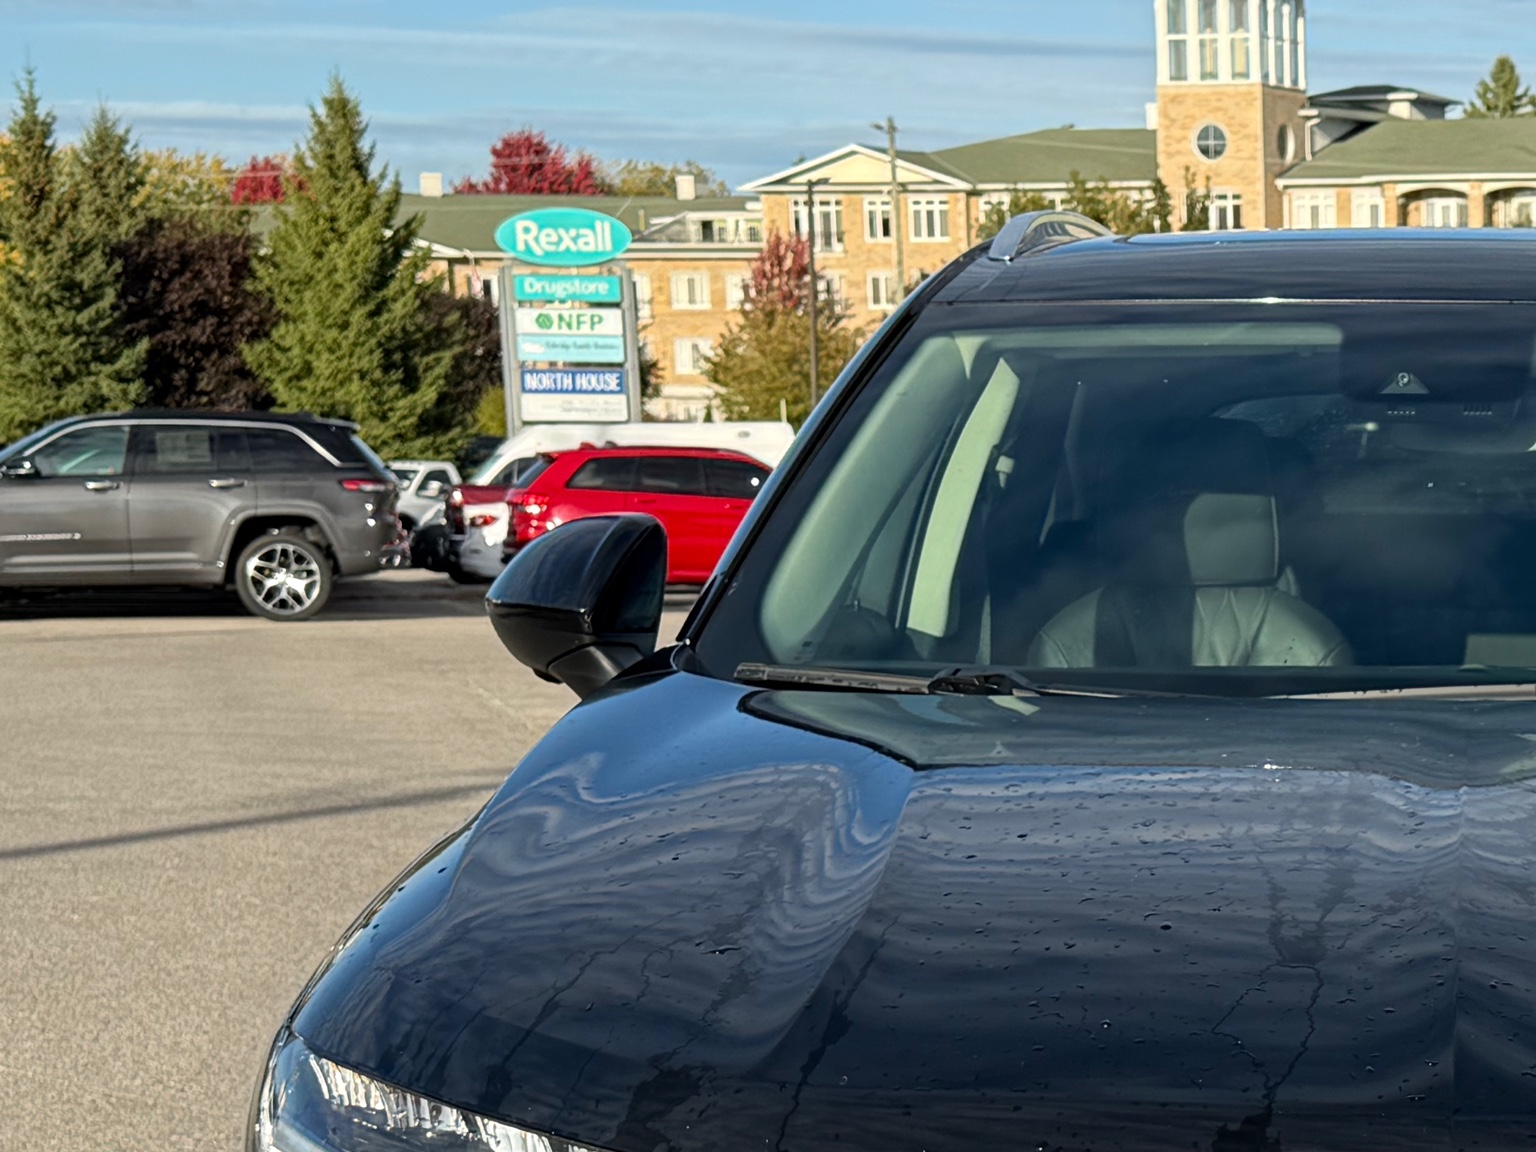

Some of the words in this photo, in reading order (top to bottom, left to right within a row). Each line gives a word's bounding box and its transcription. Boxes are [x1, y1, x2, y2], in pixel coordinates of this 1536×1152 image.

[515, 219, 613, 256] Rexall
[524, 276, 609, 298] Drugstore
[557, 313, 604, 331] NFP
[524, 372, 573, 391] NORTH
[575, 372, 621, 392] HOUSE
